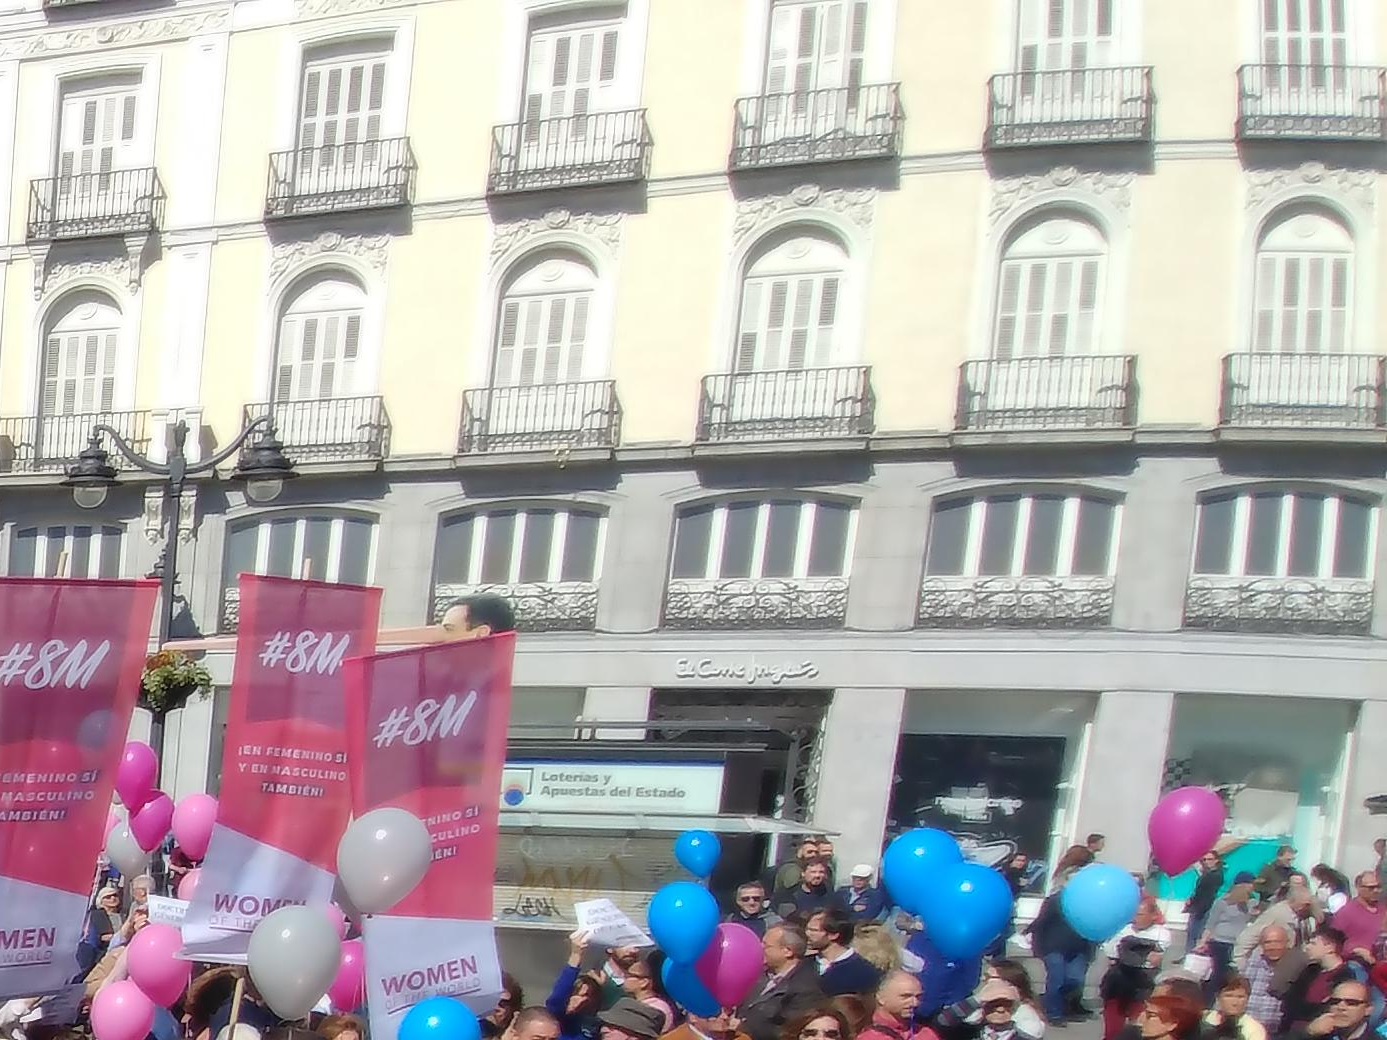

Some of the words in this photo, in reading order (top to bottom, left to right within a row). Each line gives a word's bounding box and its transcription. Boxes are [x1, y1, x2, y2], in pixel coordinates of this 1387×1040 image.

[259, 629, 349, 675] #8M
[373, 689, 477, 748] #8M
[267, 746, 331, 762] FEMENINO
[238, 762, 247, 772] Y
[251, 763, 267, 775] EN
[271, 764, 346, 780] MASCULINO
[541, 771, 598, 783] Loterías
[603, 774, 612, 785] y
[1, 790, 95, 803] MASCULINO
[261, 781, 324, 797] TAMBIÉN!
[540, 786, 606, 798] Apuestas
[609, 786, 632, 798] del
[636, 787, 686, 798] Estado
[431, 824, 480, 843] CULINO
[214, 893, 306, 917] WOM
[381, 956, 477, 996] WOMEN
